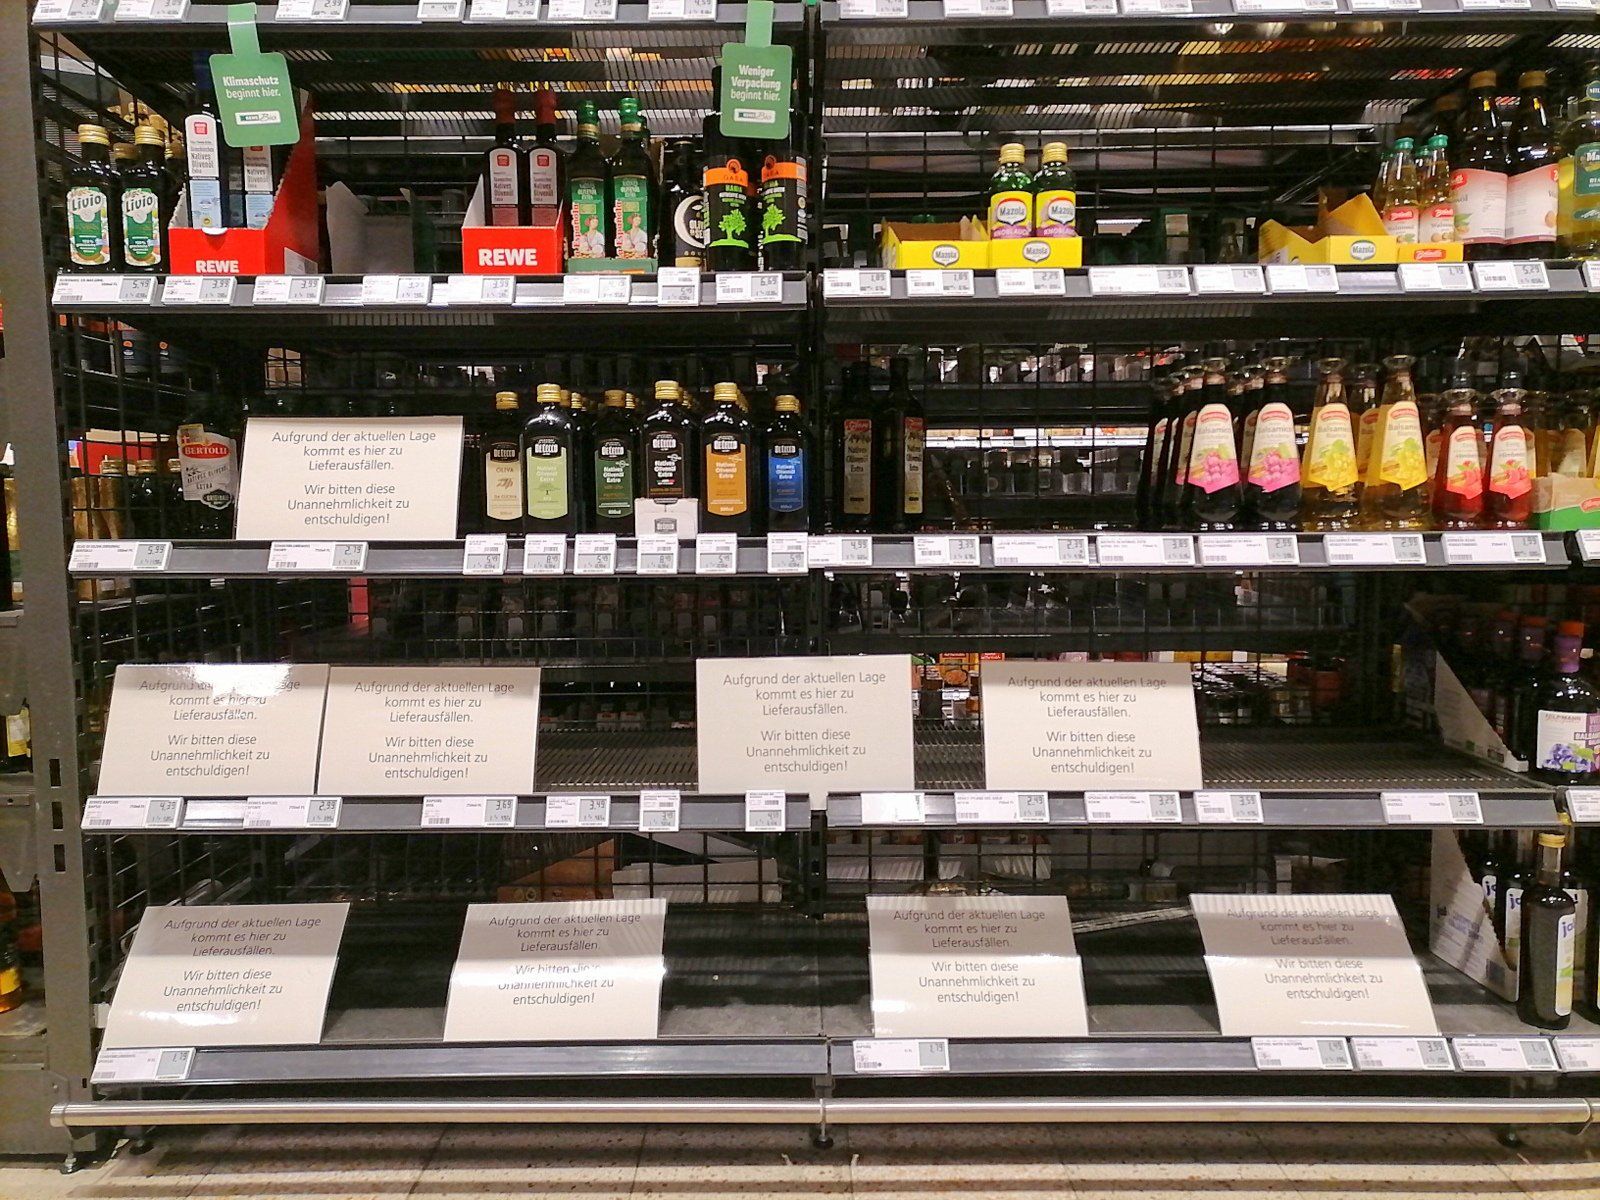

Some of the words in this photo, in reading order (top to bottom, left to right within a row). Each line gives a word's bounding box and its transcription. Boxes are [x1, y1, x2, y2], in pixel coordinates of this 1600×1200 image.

[738, 64, 775, 78] Weniger
[222, 76, 279, 87] Klimaschutz
[731, 76, 781, 91] Verpackung
[226, 88, 260, 100] beginnt
[262, 87, 281, 97] hier.
[730, 89, 761, 101] beginnt
[764, 90, 780, 101] hier.
[1000, 206, 1025, 216] Mazola
[1026, 247, 1048, 255] Mazola
[1352, 246, 1374, 254] Mazola
[478, 247, 538, 267] REWE
[195, 260, 239, 273] REWE
[271, 431, 327, 445] Aufgrund
[331, 431, 351, 442] der
[353, 430, 406, 442] aktuellen
[409, 431, 436, 443] Lage
[184, 447, 227, 455] BERTOLLI
[303, 445, 344, 457] kommt
[348, 447, 361, 456] es
[364, 445, 386, 456] hier
[389, 447, 403, 456] zu
[308, 458, 394, 471] Lieferausfällen.
[304, 484, 325, 495] Wir
[328, 483, 363, 495] bitten
[366, 483, 395, 494] diese
[287, 498, 393, 511] Unannehmlichkeit
[396, 500, 410, 509] zu
[304, 512, 390, 527] entschuldigen!
[723, 674, 778, 688] Aufgrund
[781, 673, 801, 685] der
[803, 672, 856, 684] aktuellen
[859, 672, 886, 685] Lage
[1008, 677, 1061, 689] Aufgrund
[1064, 677, 1082, 687] der
[1086, 677, 1137, 687] aktuellen
[1140, 677, 1166, 689] Lage
[354, 682, 409, 694] Aufgrund
[412, 681, 431, 692] der
[433, 681, 484, 693] aktuellen
[488, 682, 515, 695] Lage
[755, 688, 797, 700] kommt
[800, 690, 812, 699] es
[815, 688, 837, 699] hier
[841, 690, 854, 699] zu
[169, 695, 209, 705] kommt
[385, 696, 425, 708] kommt
[429, 698, 441, 707] es
[444, 696, 465, 707] hier
[468, 698, 482, 707] zu
[1040, 691, 1080, 703] kommt
[1083, 693, 1097, 702] es
[1099, 691, 1120, 702] hier
[1123, 694, 1137, 703] zu
[173, 709, 258, 721] Lieferausfällen.
[762, 703, 847, 716] Lieferausfällen.
[1047, 705, 1131, 718] Lieferausfällen.
[390, 710, 473, 723] Lieferausfällen.
[168, 735, 188, 745] Wir
[191, 734, 224, 745] bitten
[228, 733, 257, 744] diese
[385, 736, 405, 748] Wir
[408, 736, 442, 747] bitten
[446, 735, 475, 747] diese
[760, 730, 782, 741] Wir
[784, 729, 818, 742] bitten
[821, 728, 851, 741] diese
[1046, 731, 1068, 742] Wir
[1070, 731, 1104, 742] bitten
[1107, 731, 1136, 742] diese
[150, 750, 253, 762] Unannehmlichkeit
[256, 751, 270, 760] zu
[746, 744, 850, 757] Unannehmlichkeit
[852, 746, 866, 756] zu
[1032, 745, 1137, 758] Unannehmlichkeit
[1139, 749, 1152, 758] zu
[368, 751, 472, 764] Unannehmlichkeit
[474, 752, 488, 762] zu
[166, 764, 250, 778] entschuldigen!
[384, 766, 469, 781] entschuldigen!
[764, 760, 848, 774] entschuldigen!
[1051, 761, 1134, 776] entschuldigen!
[489, 915, 540, 928] Aufgrund
[543, 915, 560, 924] der
[564, 914, 612, 924] aktuellen
[616, 914, 641, 925] Lage
[893, 910, 945, 922] Aufgrund
[947, 910, 966, 921] der
[969, 910, 1017, 921] aktuellen
[1020, 911, 1045, 922] Lage
[164, 919, 219, 931] Aufgrund
[221, 918, 240, 929] der
[242, 917, 292, 929] aktuellen
[295, 917, 322, 929] Lage
[924, 924, 964, 935] kommt
[966, 926, 978, 934] es
[981, 924, 1003, 934] hier
[1005, 926, 1018, 935] zu
[190, 932, 232, 944] kommt
[234, 933, 246, 942] es
[248, 931, 271, 942] hier
[273, 932, 287, 941] zu
[517, 928, 555, 938] kommt
[558, 929, 570, 937] es
[573, 927, 594, 937] hier
[596, 928, 609, 936] zu
[932, 937, 1012, 948] Lieferausfällen.
[1271, 935, 1352, 945] Lieferausfällen.
[192, 945, 275, 957] Lieferausfällen.
[516, 964, 534, 974] Wir
[931, 961, 952, 972] Wir
[954, 961, 988, 972] bitten
[990, 961, 1019, 972] diese
[1275, 959, 1295, 969] Wir
[1300, 958, 1332, 968] bitten
[1335, 958, 1363, 968] diese
[183, 970, 203, 982] Wir
[206, 970, 239, 982] bitten
[242, 969, 272, 980] diese
[918, 976, 1019, 988] Unannehmlichkeit
[1022, 978, 1036, 987] zu
[1265, 973, 1366, 984] Unannehmlichkeit
[1370, 975, 1383, 983] zu
[600, 979, 614, 988] zu
[163, 984, 267, 997] Unannehmlichkeit
[269, 985, 283, 994] zu
[1286, 987, 1369, 1001] entschuldigen!
[513, 992, 595, 1006] entschuldigen!
[937, 990, 1019, 1005] entschuldigen!
[176, 998, 261, 1014] entschuldigen!
